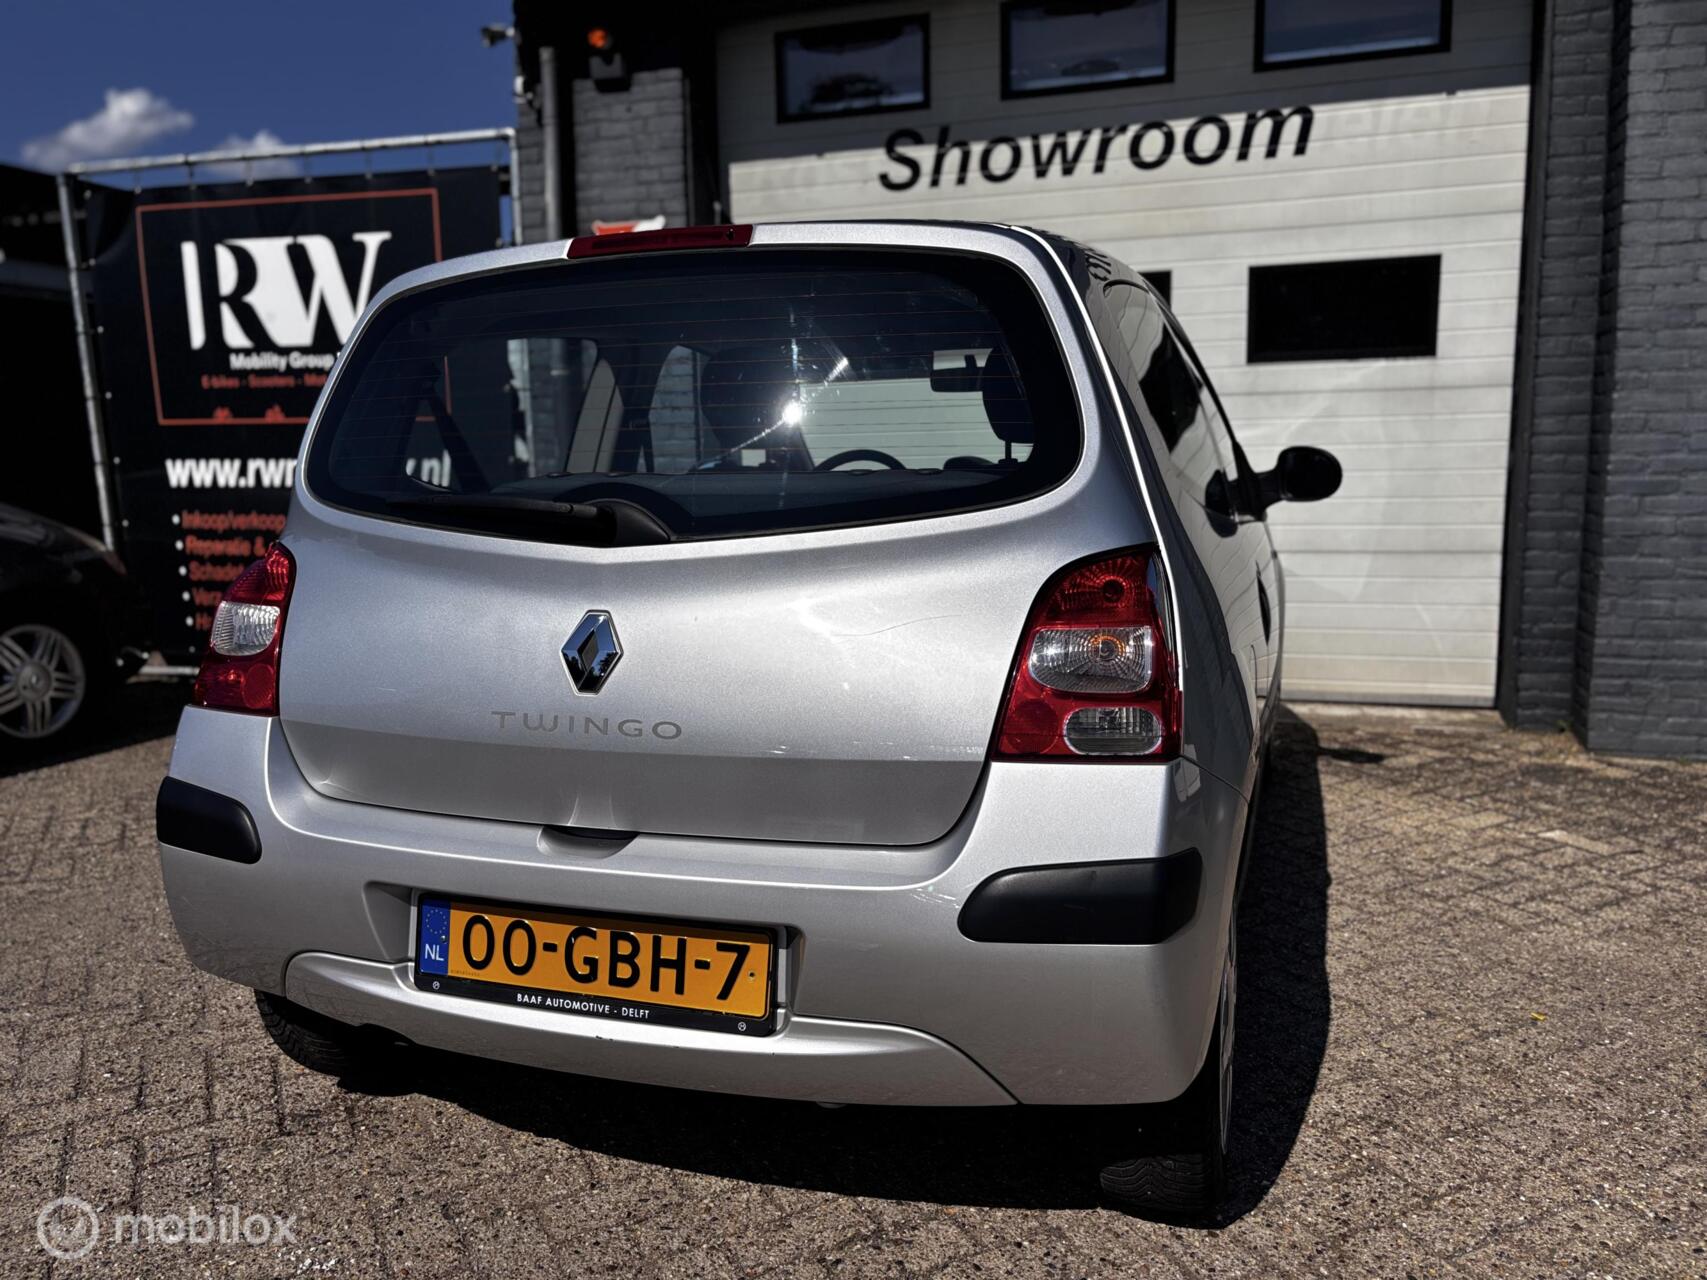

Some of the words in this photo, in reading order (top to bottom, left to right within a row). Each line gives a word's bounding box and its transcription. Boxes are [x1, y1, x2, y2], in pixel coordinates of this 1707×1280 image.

[879, 104, 1314, 192] Showroom
[181, 231, 392, 350] RW
[229, 351, 287, 371] Mobility
[288, 350, 335, 371] Group
[491, 710, 682, 740] TWINGO
[424, 943, 445, 962] NL
[462, 914, 750, 1001] 00-GBH-7
[516, 993, 542, 1005] BAAF
[545, 997, 610, 1014] AUTOMOTIVE
[621, 1007, 650, 1019] DELFT
